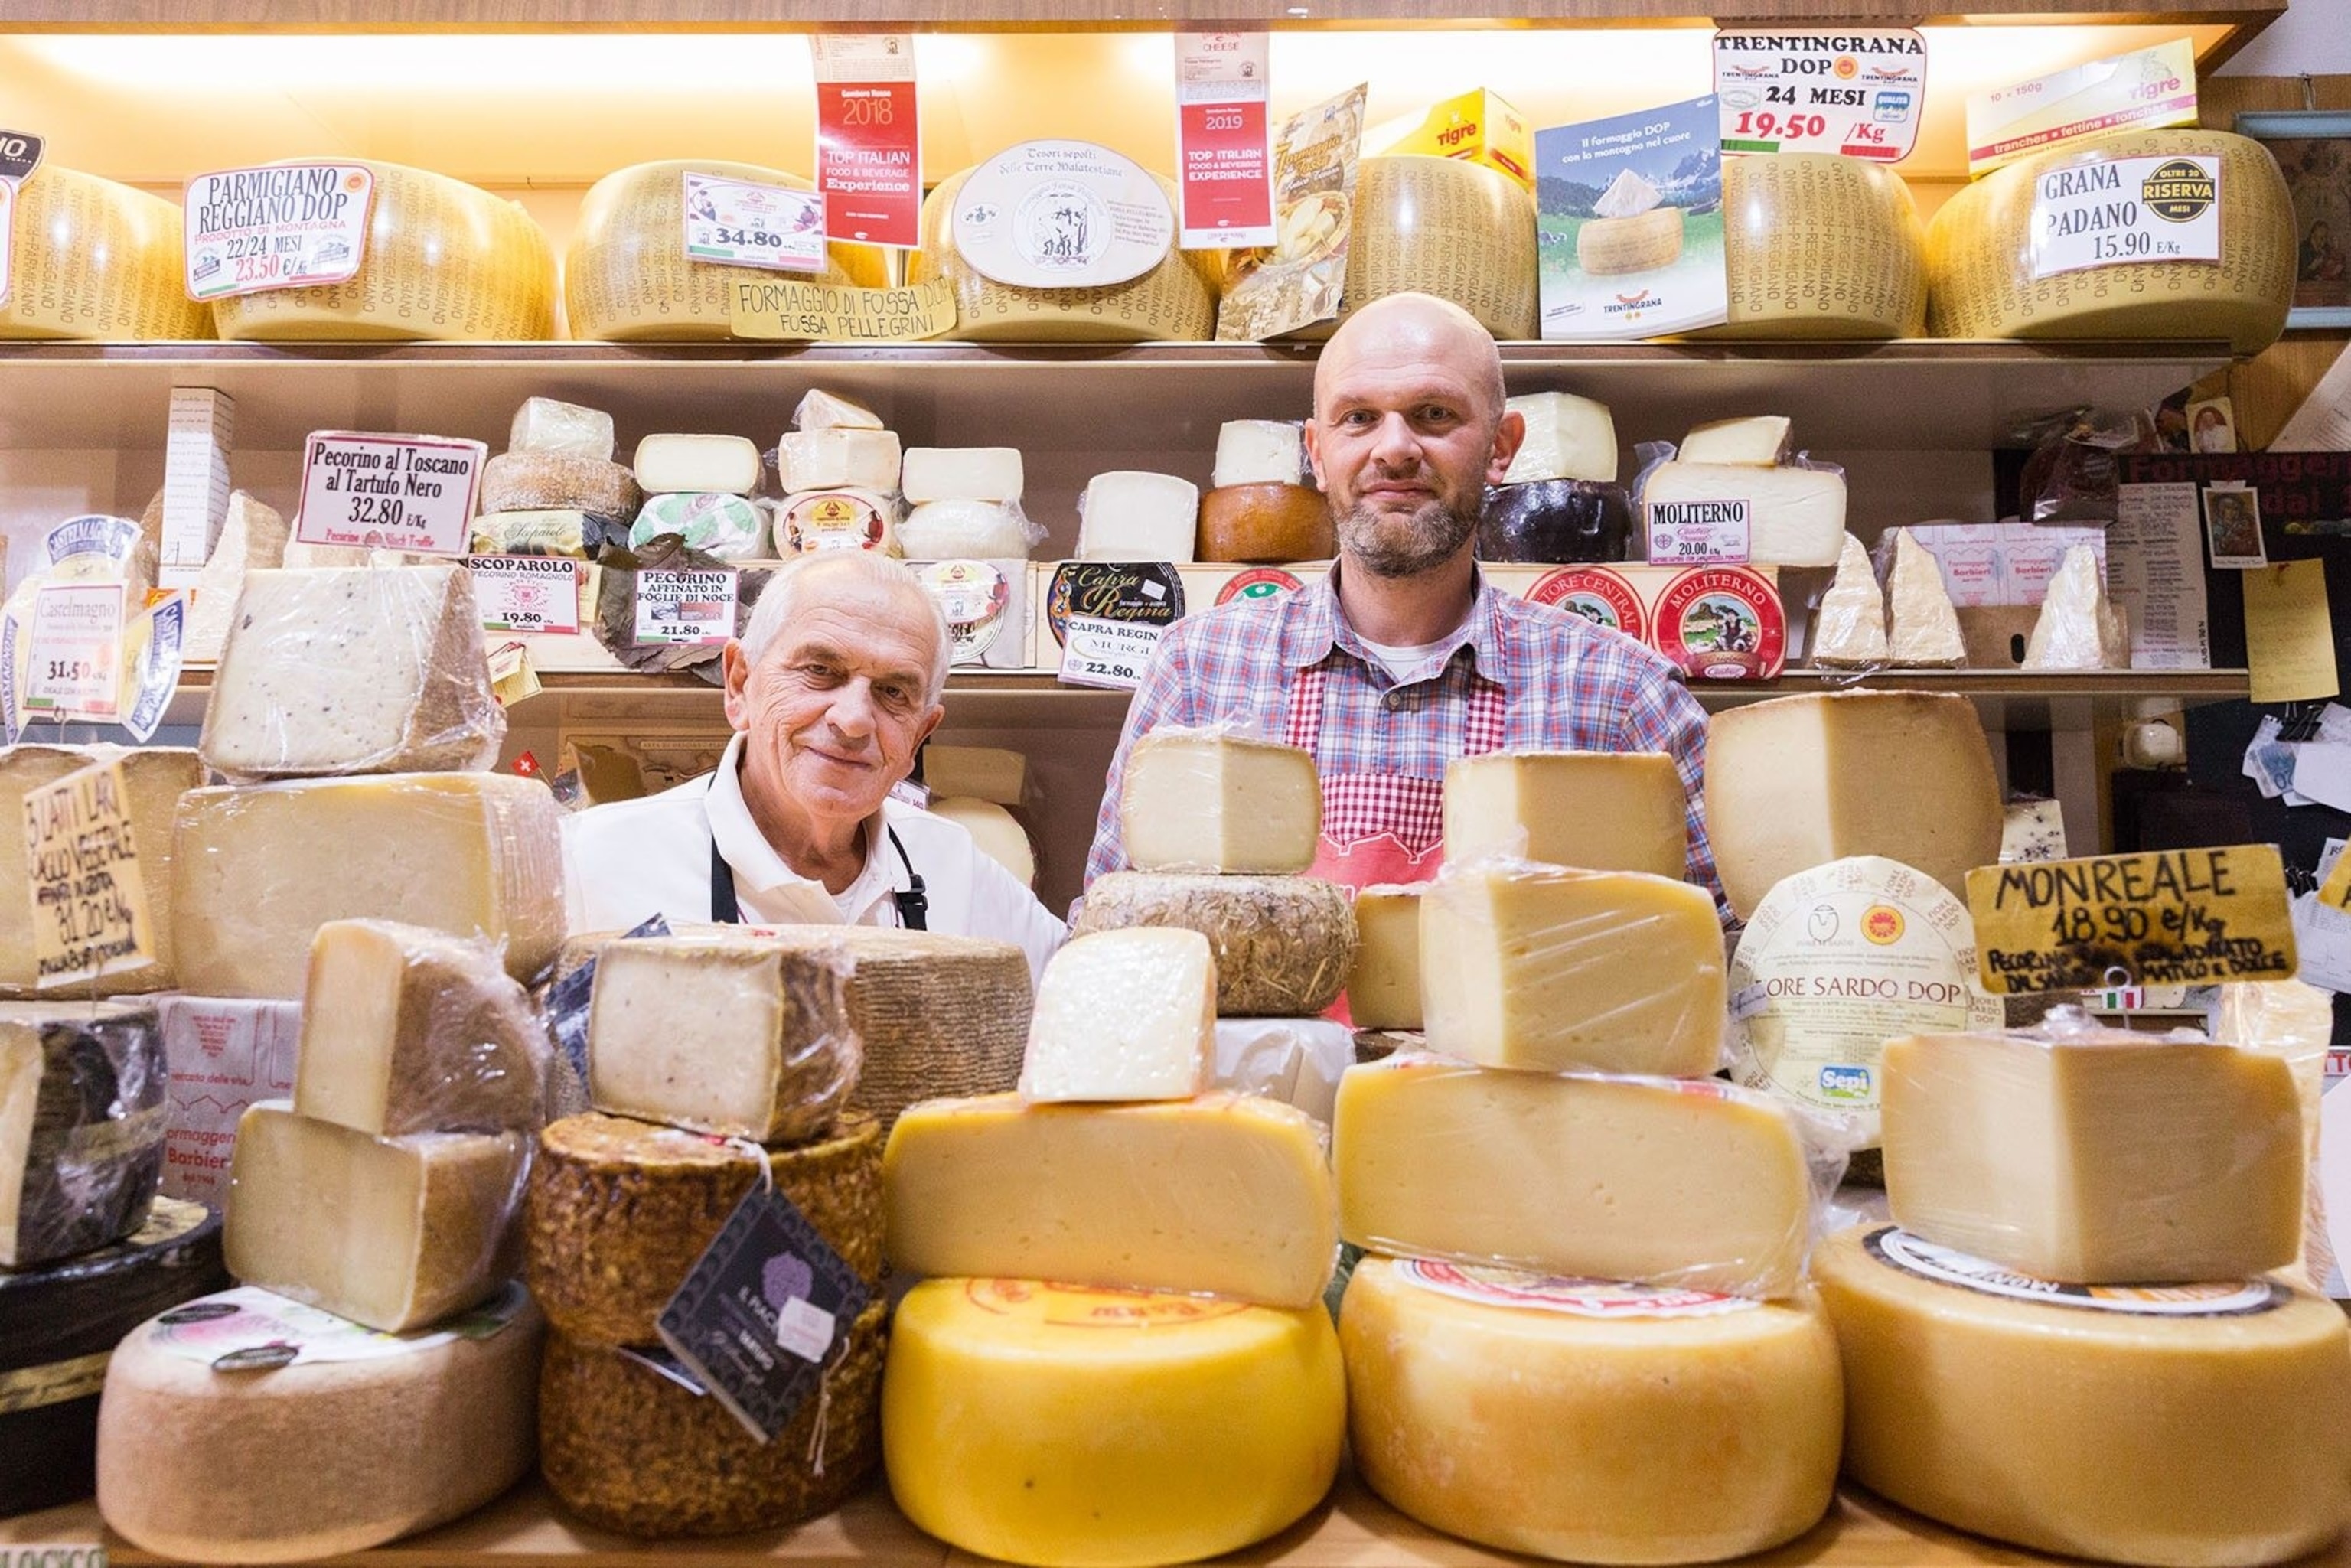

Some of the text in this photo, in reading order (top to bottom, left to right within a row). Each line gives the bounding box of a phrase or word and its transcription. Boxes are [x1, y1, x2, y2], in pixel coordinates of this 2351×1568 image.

[1715, 37, 1924, 54] TRENTINGRANA
[1781, 58, 1831, 75] DOP
[1766, 86, 1795, 105] 24
[1810, 88, 1866, 106] MESI
[2016, 82, 2043, 96] 150g
[843, 98, 892, 125] 2018
[1206, 116, 1243, 130] 2019
[1645, 122, 1671, 136] DOP
[1735, 112, 1826, 139] 19.50
[1562, 154, 1581, 164] con
[1646, 137, 1661, 149] nel
[1662, 131, 1691, 145] cuore
[1994, 132, 2049, 154] tranches
[827, 151, 910, 165] TOP ITALIAN
[1188, 148, 1262, 161] TOP ITALIAN
[827, 168, 850, 177] FOOD
[862, 168, 909, 178] BEVERAGE
[1189, 171, 1263, 181] EXPERIENCE
[2046, 164, 2121, 200] GRANA
[208, 168, 338, 206] PARMIGIANO
[826, 178, 910, 192] Experience
[2143, 182, 2213, 198] RISERVA
[198, 191, 349, 235] REGGIANO DOP
[2048, 201, 2137, 237] PADANO
[2170, 205, 2190, 214] MESI
[275, 220, 347, 232] MONTAGNA
[227, 235, 302, 259] 22/24 MESI
[716, 228, 781, 247] 34.80
[2094, 231, 2150, 259] 15.90
[234, 255, 280, 282] 23.50
[739, 284, 837, 314] FORMAGGIO
[844, 294, 856, 312] DI
[863, 290, 920, 315] FOSSA
[1604, 298, 1662, 314] TRENTINGRANA
[781, 314, 934, 337] FOSSA PELLEGRINI
[313, 442, 468, 475] Pecorino al Toscano
[326, 468, 442, 498] al Tartufo Nero
[348, 497, 403, 525] 32.80
[1653, 502, 1743, 524] MOLITERNO
[1679, 542, 1707, 555] 20.00
[471, 559, 573, 572] SCOPAROLO
[520, 572, 574, 581] ROMAGNOLO
[644, 572, 726, 585] PECORINO
[1078, 566, 1139, 595] Capra
[638, 592, 734, 602] FOGLIE DI NOCE
[648, 584, 723, 593] AFFINATO IN
[1671, 574, 1766, 610] MOLITERNO
[1081, 585, 1170, 621] Regina
[1583, 575, 1639, 635] CENTRAL
[502, 612, 541, 622] 19.80
[660, 625, 700, 636] 21.80
[1069, 622, 1159, 641] CAPRA REGIN
[49, 660, 90, 680] 31.50
[1086, 662, 1133, 678] 22.80
[1996, 850, 2235, 910] MONREALE
[2051, 906, 2147, 946] 18.90
[1766, 976, 1961, 1003] ORE SARDO DOP
[166, 1129, 236, 1146] ormaggeri
